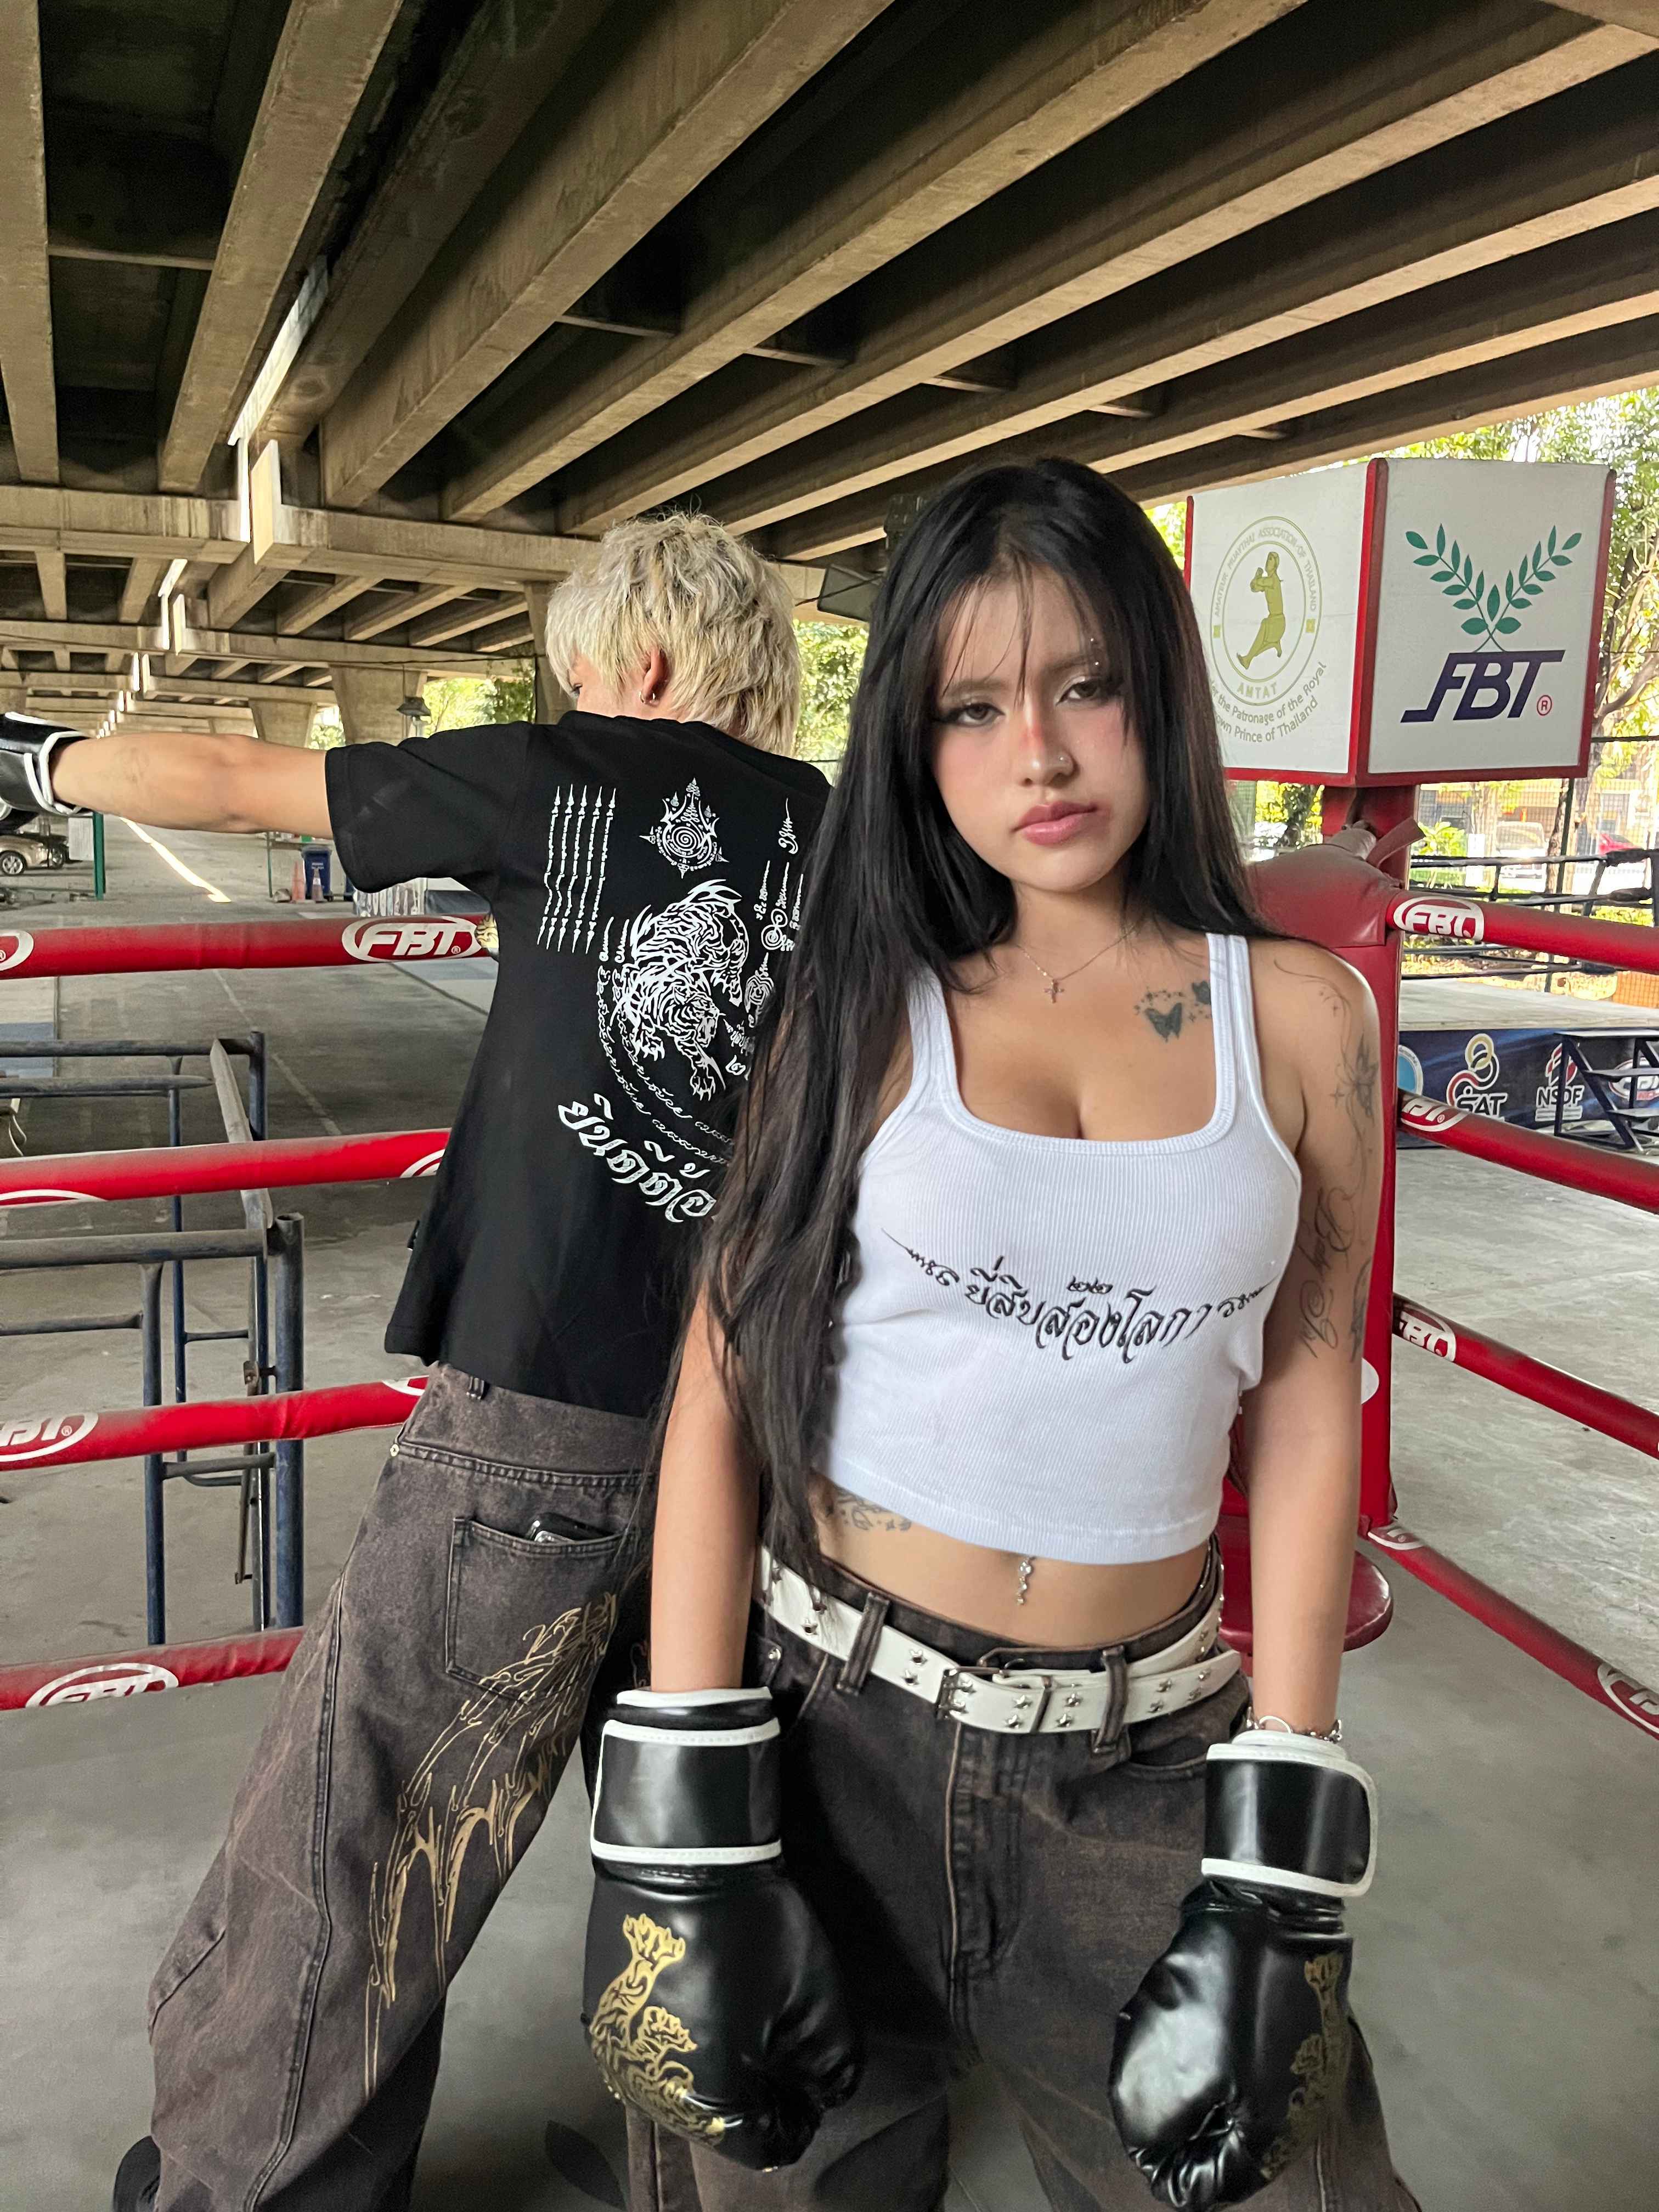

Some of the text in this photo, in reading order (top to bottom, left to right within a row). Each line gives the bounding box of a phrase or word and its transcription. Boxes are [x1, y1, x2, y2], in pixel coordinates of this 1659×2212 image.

[1304, 560, 1317, 612] THAILAND
[1218, 693, 1231, 712] the
[1232, 706, 1274, 726] Patronage
[1277, 703, 1286, 719] of
[1287, 693, 1304, 712] the
[1302, 661, 1327, 696] Royal
[1237, 682, 1277, 699] AMTAT
[1214, 695, 1318, 743] own Prince of Thailand
[1405, 904, 1476, 938] FBT
[557, 1093, 718, 1223] ยินดีต้อ
